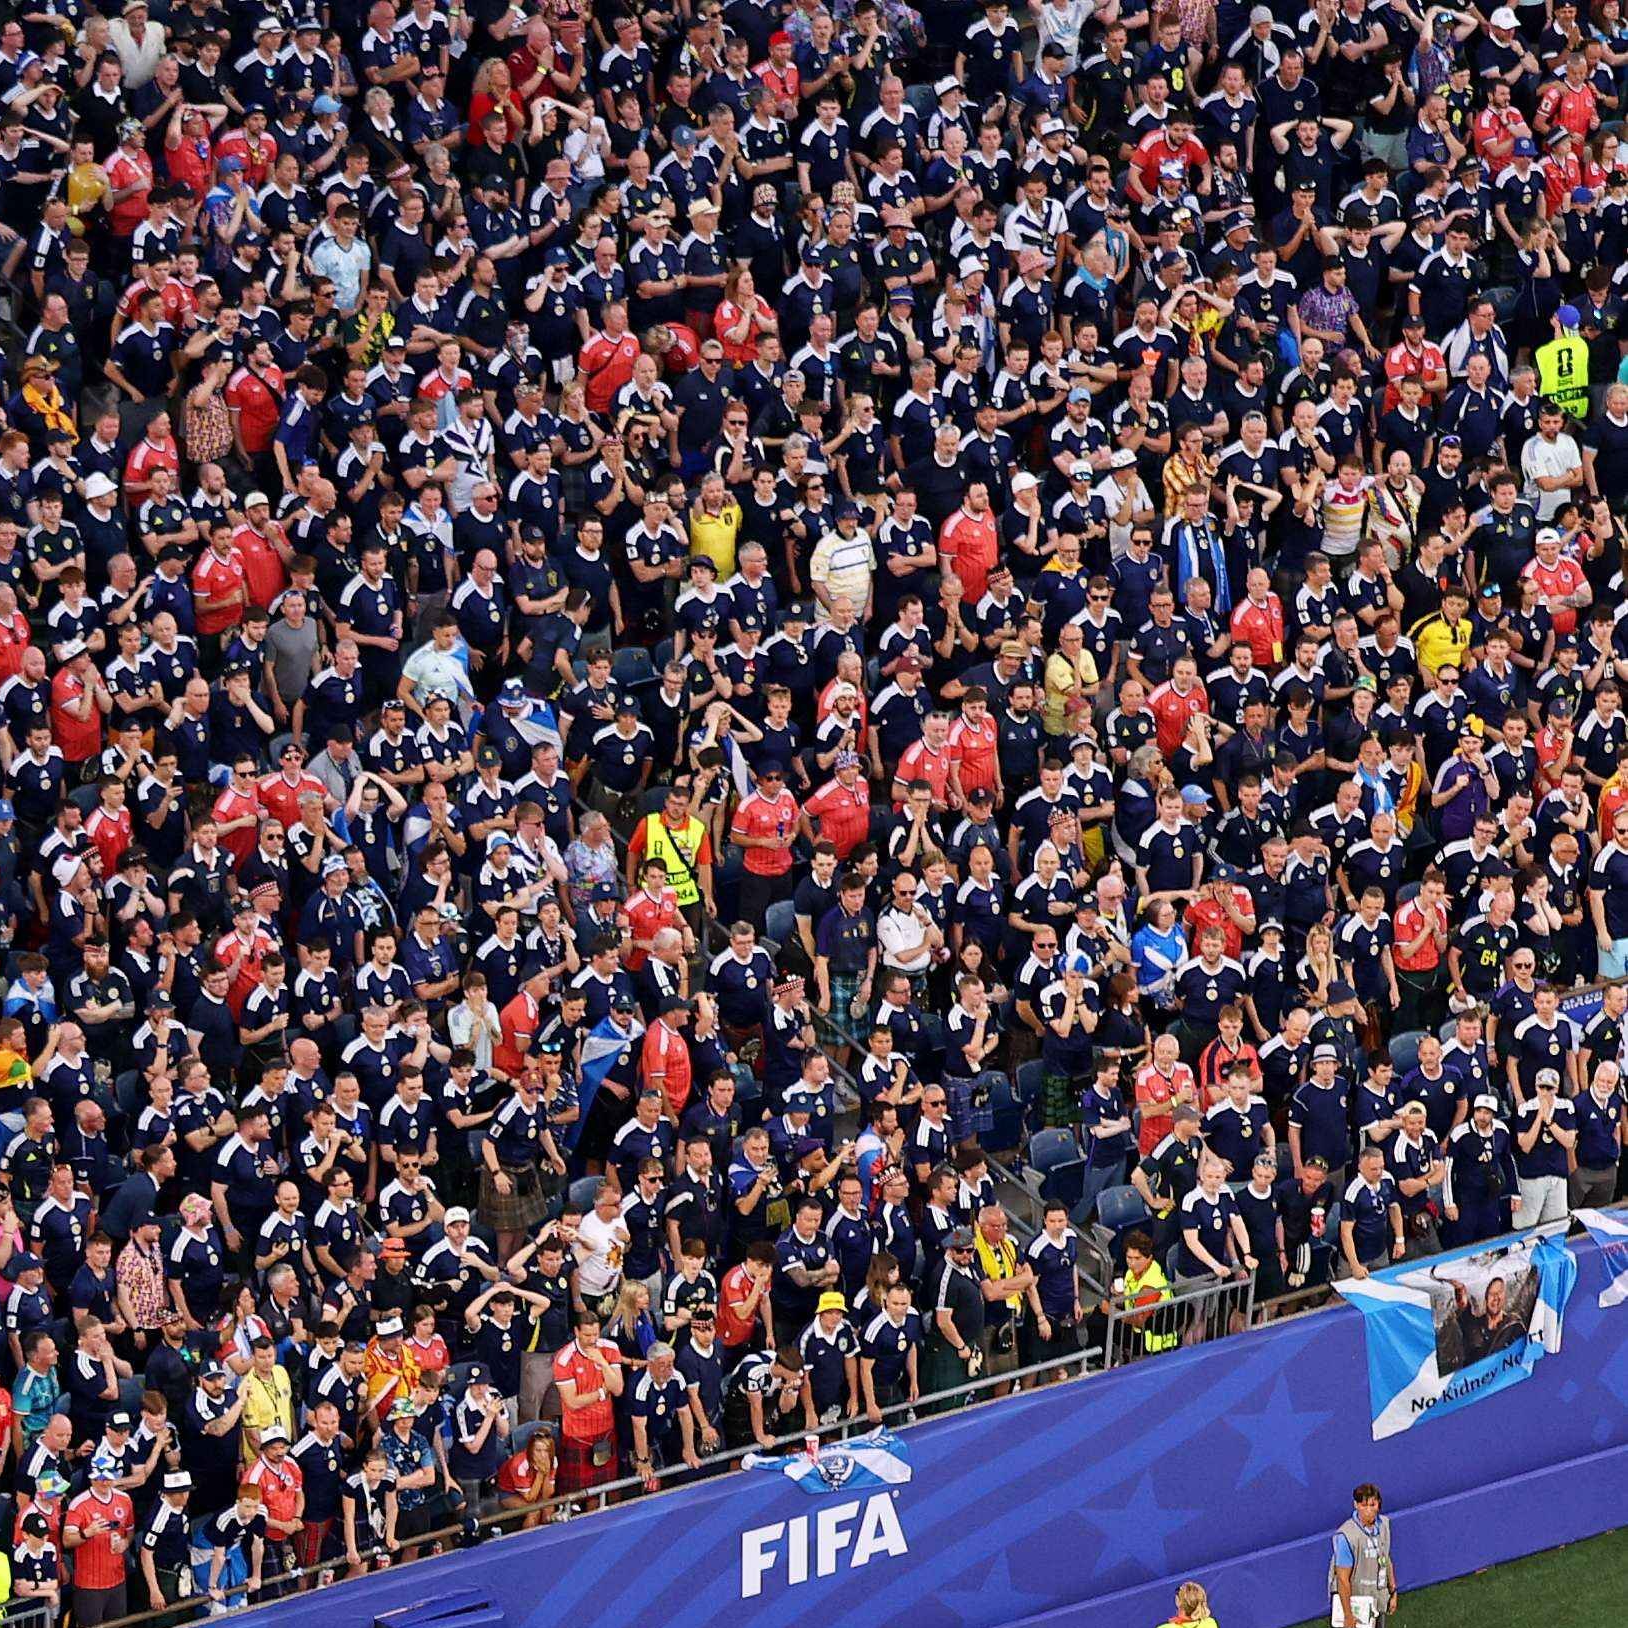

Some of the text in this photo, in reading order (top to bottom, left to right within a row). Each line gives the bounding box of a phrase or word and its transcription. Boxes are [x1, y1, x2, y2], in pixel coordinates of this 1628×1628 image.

[1480, 949, 1498, 967] 64
[1410, 1397, 1438, 1414] No
[1442, 1366, 1499, 1404] Kidney
[741, 1492, 909, 1598] FIFA
